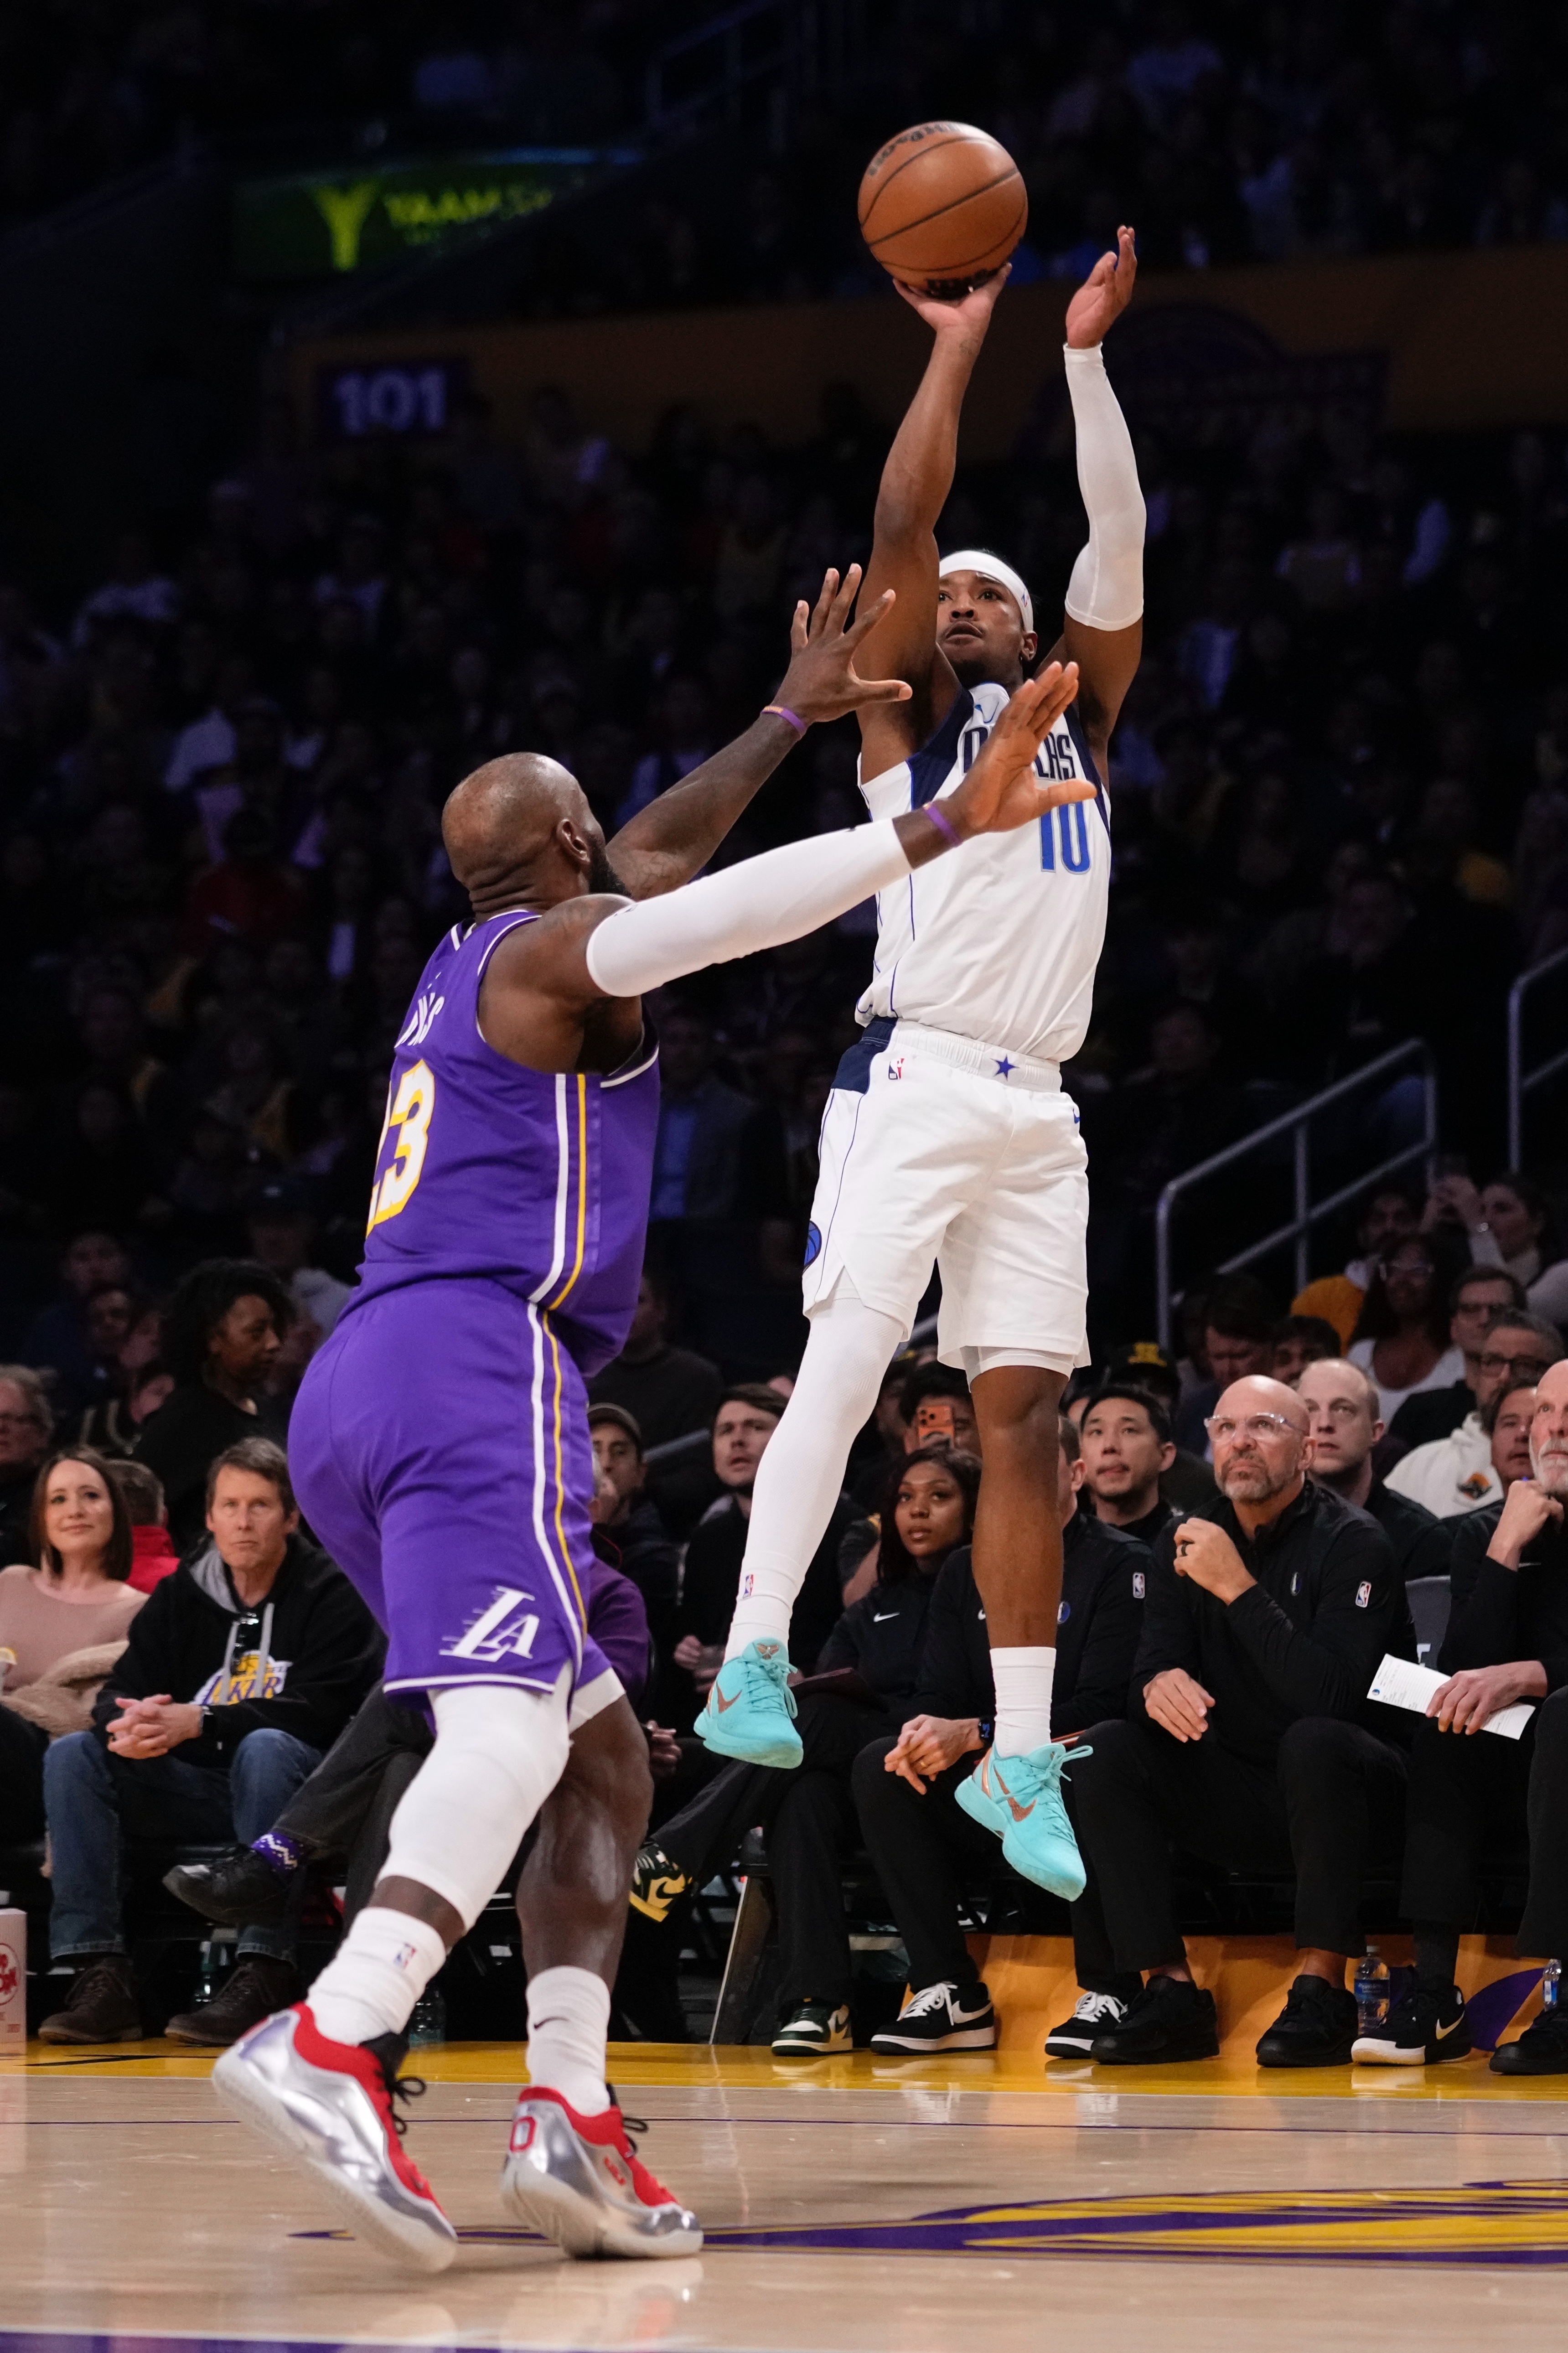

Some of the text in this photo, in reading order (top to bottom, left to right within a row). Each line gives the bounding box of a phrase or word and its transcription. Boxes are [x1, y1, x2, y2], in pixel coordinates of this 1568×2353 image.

[335, 372, 445, 433] 101
[962, 727, 1076, 781] DLAS
[1039, 802, 1092, 874] 10
[439, 1586, 539, 1662] LA
